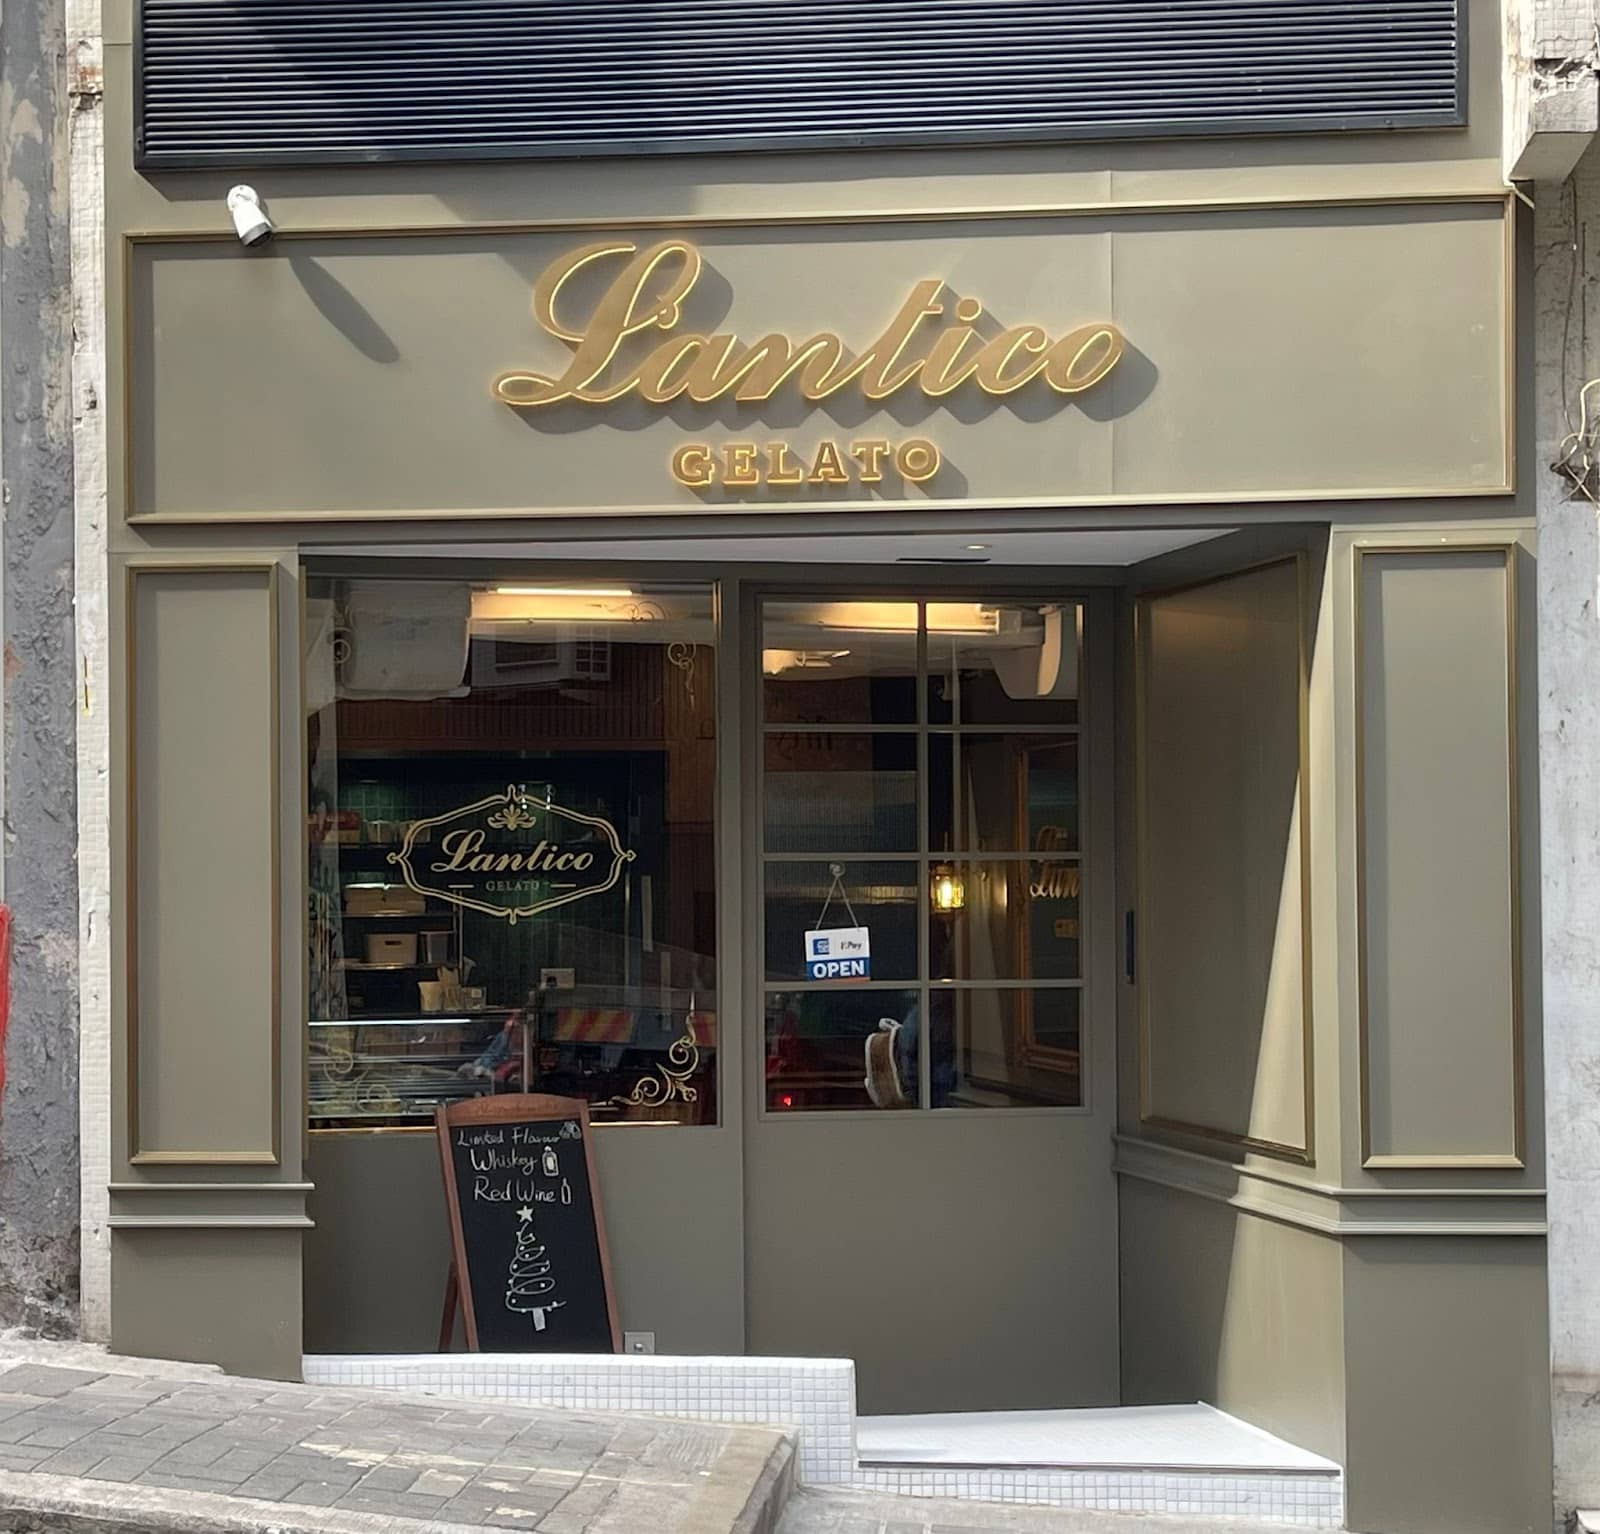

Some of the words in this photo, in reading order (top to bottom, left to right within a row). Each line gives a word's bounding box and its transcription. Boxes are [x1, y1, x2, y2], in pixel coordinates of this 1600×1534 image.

[671, 438, 942, 486] GELATO
[812, 960, 865, 979] OPEN
[474, 1175, 511, 1201] Red
[516, 1180, 556, 1202] Wine
